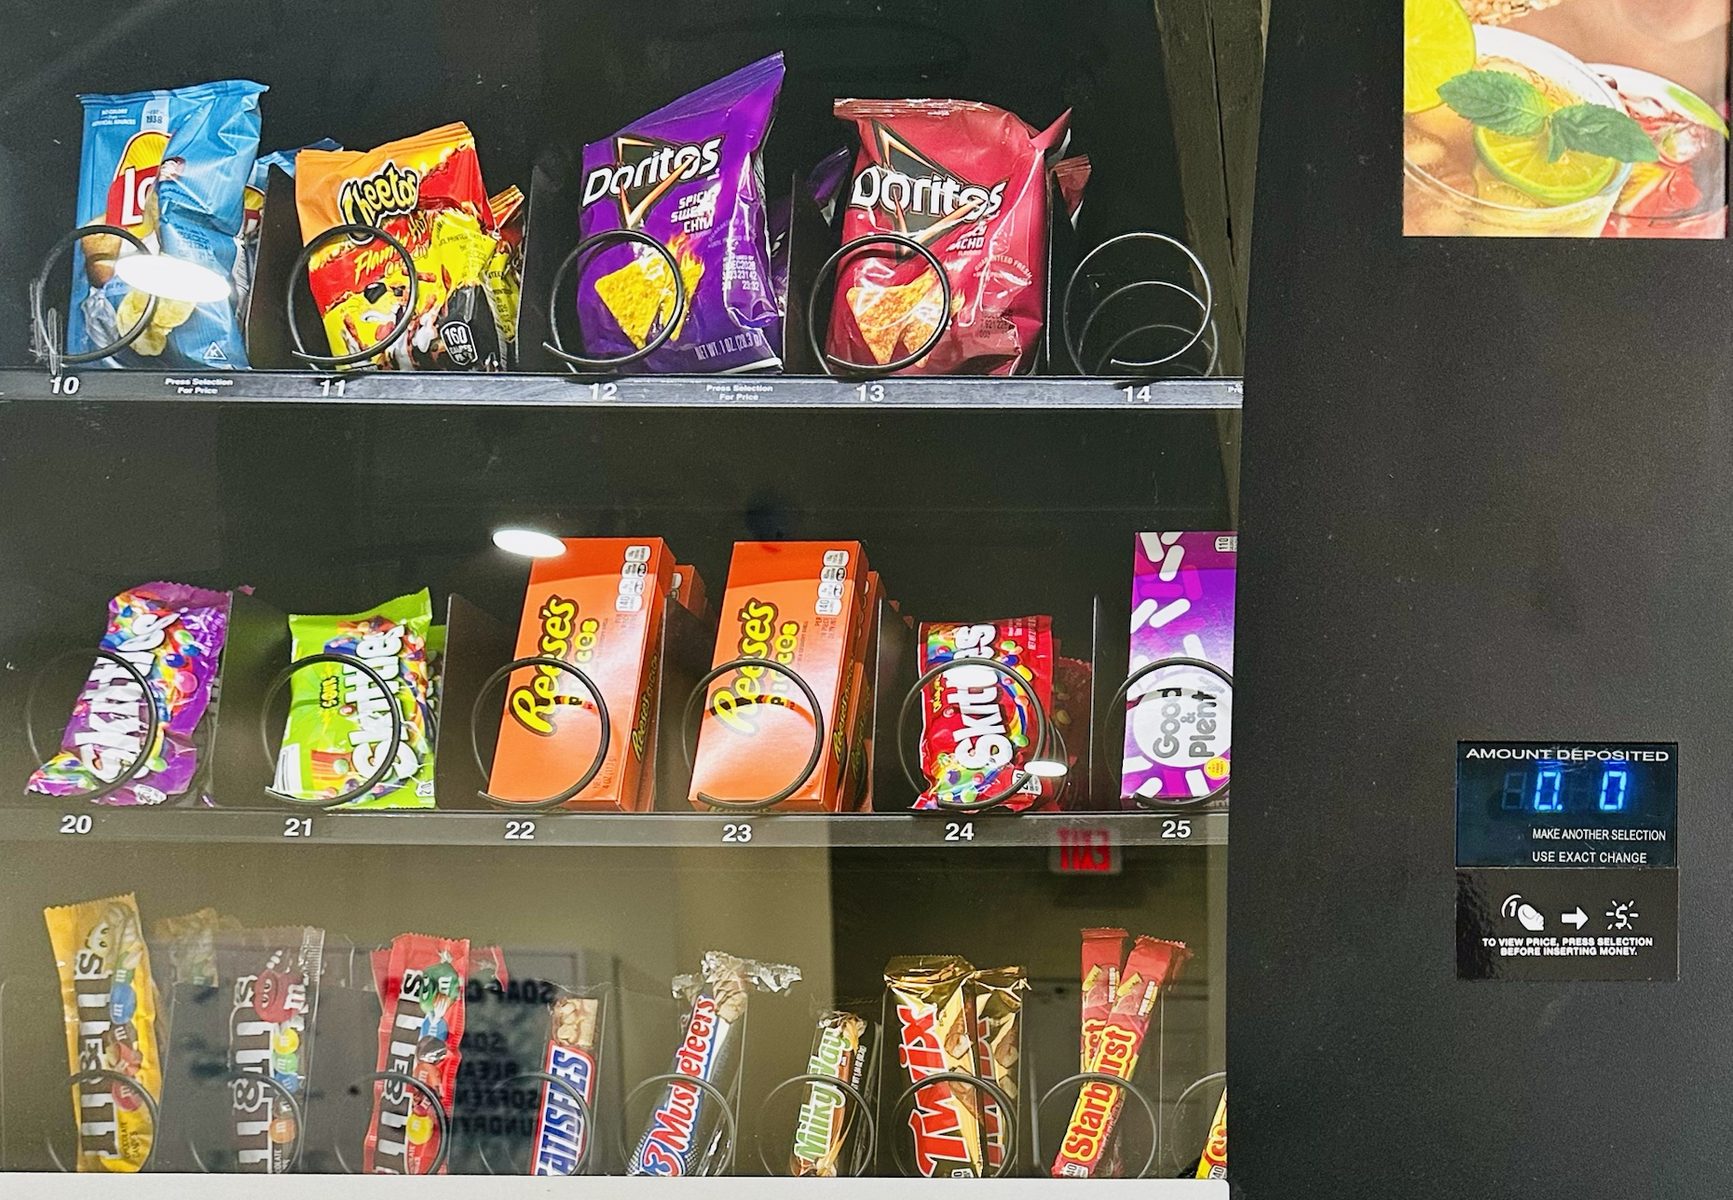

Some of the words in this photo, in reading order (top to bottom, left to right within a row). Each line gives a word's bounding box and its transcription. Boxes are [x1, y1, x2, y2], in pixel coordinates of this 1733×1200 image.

[582, 137, 723, 208] Doritos
[341, 161, 419, 240] Cheetos
[850, 165, 1008, 222] Doritos
[445, 325, 468, 346] 160
[50, 376, 80, 395] 10
[165, 377, 192, 386] Press
[192, 378, 234, 387] Selection
[177, 386, 193, 394] For
[194, 386, 219, 394] Price
[320, 379, 347, 398] 11
[706, 384, 732, 393] Press
[733, 384, 774, 393] Selection
[588, 383, 619, 401] 12
[719, 393, 735, 401] For
[736, 393, 759, 401] Price
[856, 384, 886, 402] 13
[1122, 385, 1152, 403] 14
[511, 596, 578, 735] Reese's
[712, 599, 776, 735] Reese's
[1152, 687, 1182, 759] Good
[1465, 748, 1552, 761] AMOUNT
[1556, 749, 1669, 762] DEPOSITED
[1599, 770, 1627, 811] 0
[60, 814, 93, 834] 20
[283, 817, 314, 837] 21
[504, 821, 537, 840] 22
[721, 824, 753, 843] 23
[944, 823, 975, 842] 24
[1161, 819, 1192, 839] 25
[1532, 828, 1560, 840] MAKE
[1562, 829, 1609, 841] ANOTHER
[1611, 829, 1666, 841] SELECTION
[1532, 851, 1555, 863] USE
[1558, 851, 1596, 863] EXACT
[1599, 852, 1647, 864] CHANGE
[1482, 937, 1496, 947] TO
[1499, 937, 1524, 947] VIEW
[1525, 937, 1560, 949] PRICE,
[1562, 937, 1595, 947] PRESS
[1597, 937, 1653, 947] SELECTION
[1500, 946, 1541, 956] BEFORE
[1543, 946, 1598, 957] INSERTING
[1599, 946, 1638, 957] MONEY.
[808, 1029, 852, 1078] Way
[1064, 1029, 1134, 1161] Starburst
[794, 1080, 847, 1162] Milky
[643, 1143, 682, 1176] 3
